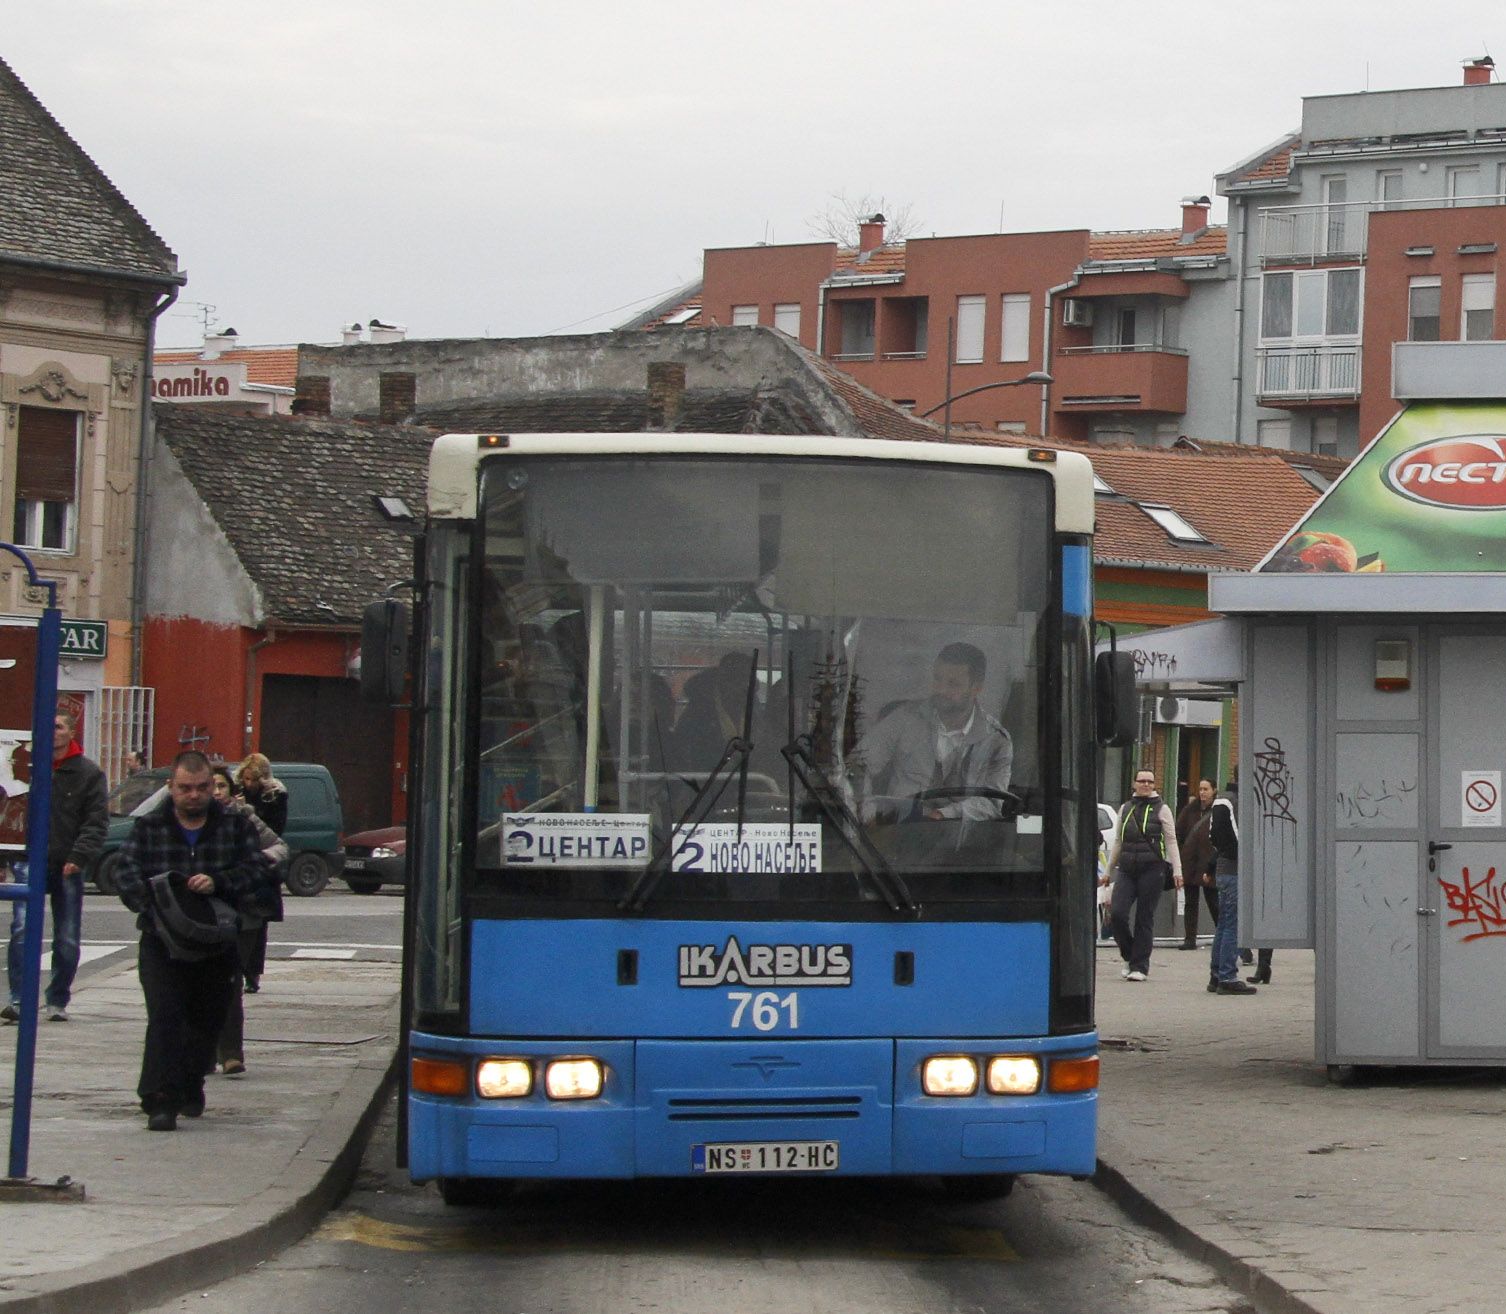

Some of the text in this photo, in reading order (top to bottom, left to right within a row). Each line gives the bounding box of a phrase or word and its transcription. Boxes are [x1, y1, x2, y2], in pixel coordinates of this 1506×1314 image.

[507, 830, 646, 863] 2 ЦЕНТАР
[679, 842, 816, 873] 2 НОВО НАСЕЉЕ
[679, 936, 851, 986] IKARBUS
[727, 991, 798, 1031] 761
[709, 1148, 736, 1169] NS
